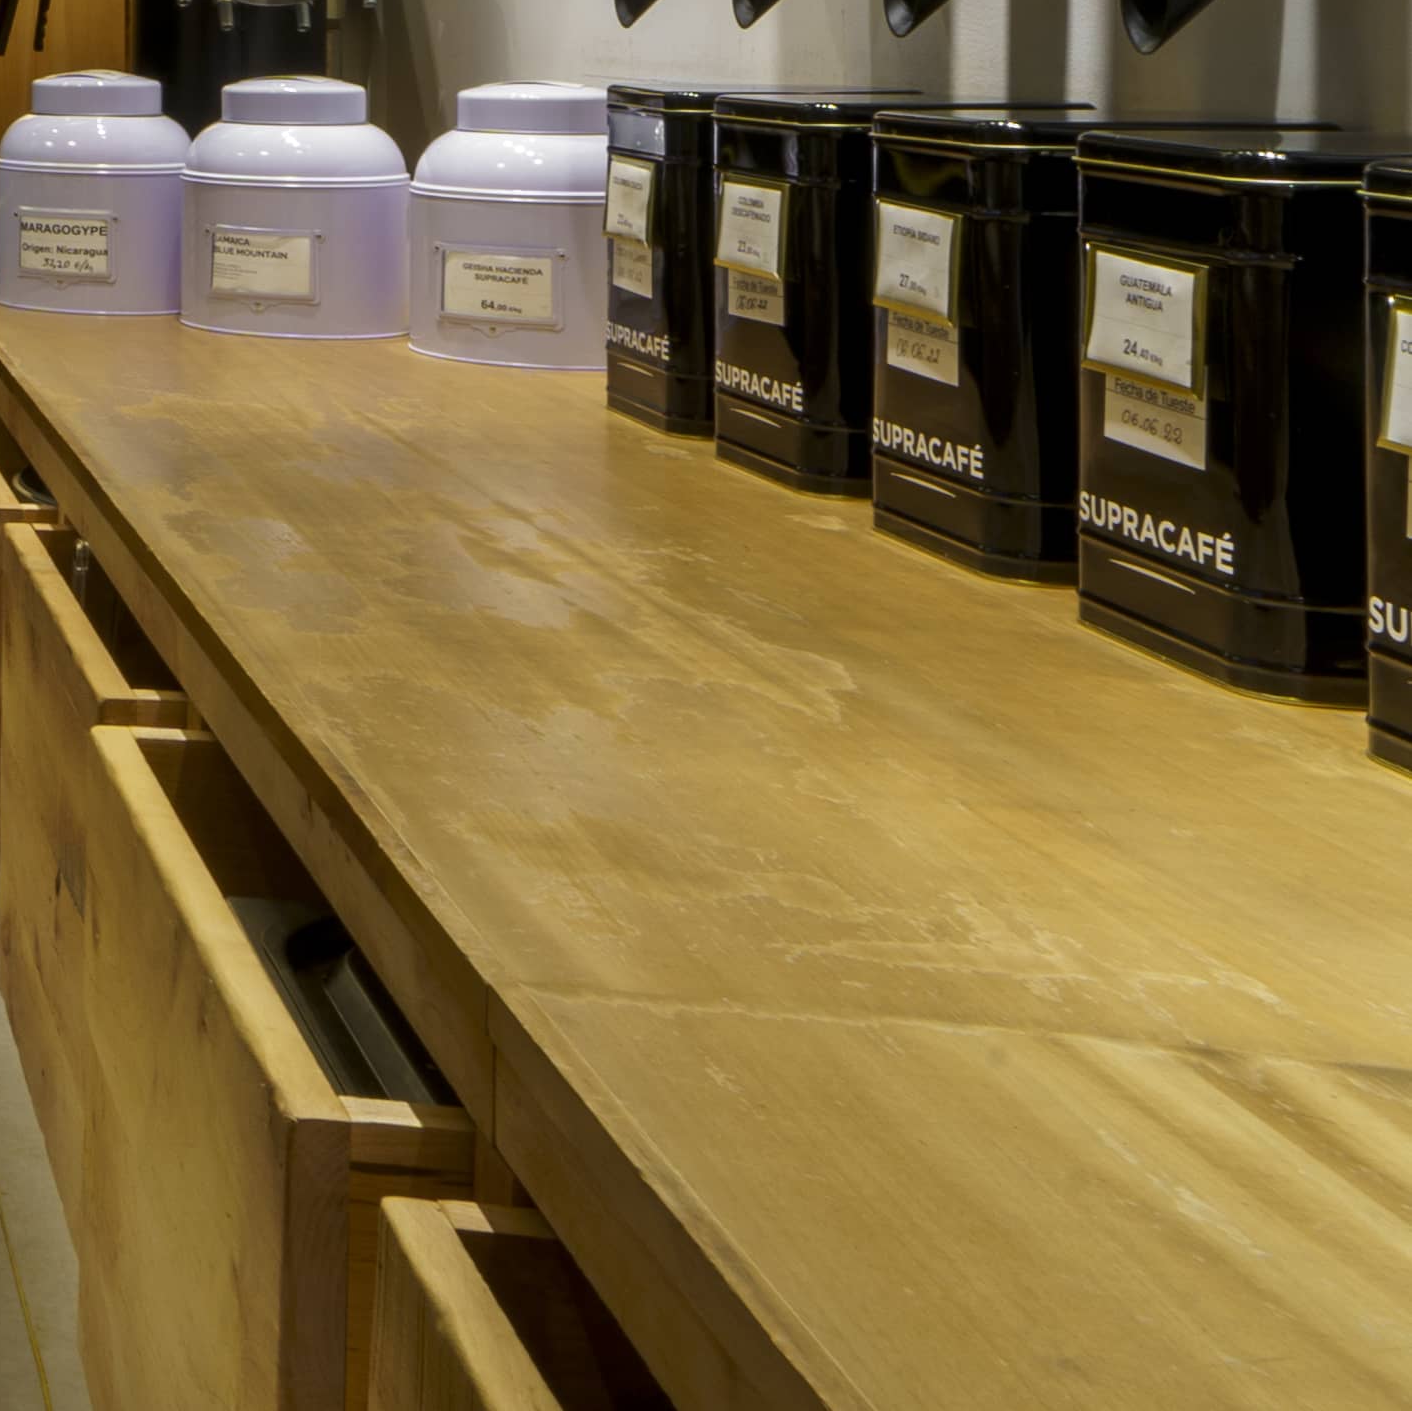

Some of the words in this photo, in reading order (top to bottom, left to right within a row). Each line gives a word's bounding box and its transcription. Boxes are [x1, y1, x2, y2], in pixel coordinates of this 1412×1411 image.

[20, 221, 108, 237] MARAGOGYPE
[56, 244, 109, 258] Nicaragua
[236, 248, 288, 260] MOUNTAIN
[1120, 274, 1173, 298] GUATEMALA
[1125, 293, 1163, 313] ANTIGUA
[606, 321, 671, 361] SUPRACAFÉ
[715, 360, 804, 411] SUPRACAFÉ
[1114, 377, 1144, 401] Fecha
[1145, 386, 1158, 403] de
[1158, 389, 1197, 416] Tueste
[872, 416, 985, 480] SUPRACAFÉ
[1079, 490, 1235, 575] SUPRACAFÉ
[1368, 595, 1412, 644] SU
